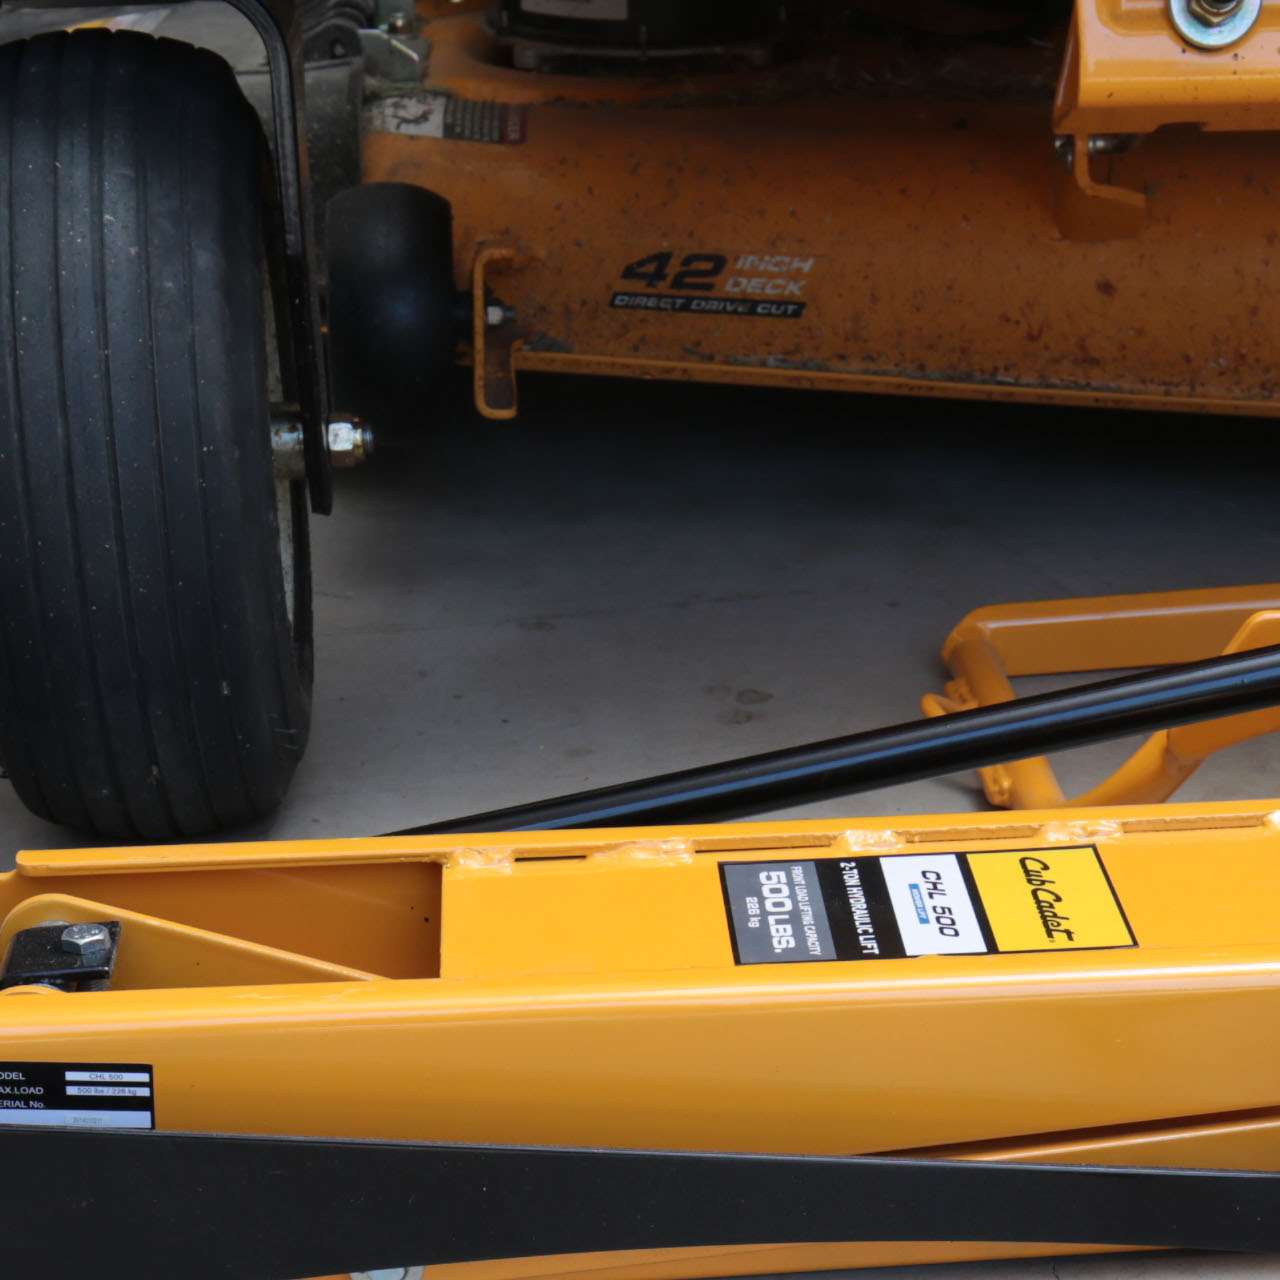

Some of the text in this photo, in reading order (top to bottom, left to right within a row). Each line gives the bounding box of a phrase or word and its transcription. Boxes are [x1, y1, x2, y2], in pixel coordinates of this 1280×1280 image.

[622, 252, 727, 291] 42
[736, 256, 815, 272] INCH
[725, 277, 808, 295] DECK
[615, 295, 799, 315] DIRECT DRIVE CUT
[743, 896, 763, 927] 226 kg
[757, 870, 797, 953] 500 LBS.
[788, 865, 823, 955] FRONT LOAD LIFTING CAPACITY
[838, 861, 880, 954] 2-TON HYDRAULIC LIFT
[919, 869, 961, 937] CHL 500
[1017, 856, 1078, 942] Cub Cadet
[109, 1073, 123, 1081] 500
[128, 1088, 137, 1096] kg
[29, 1101, 46, 1109] No.
